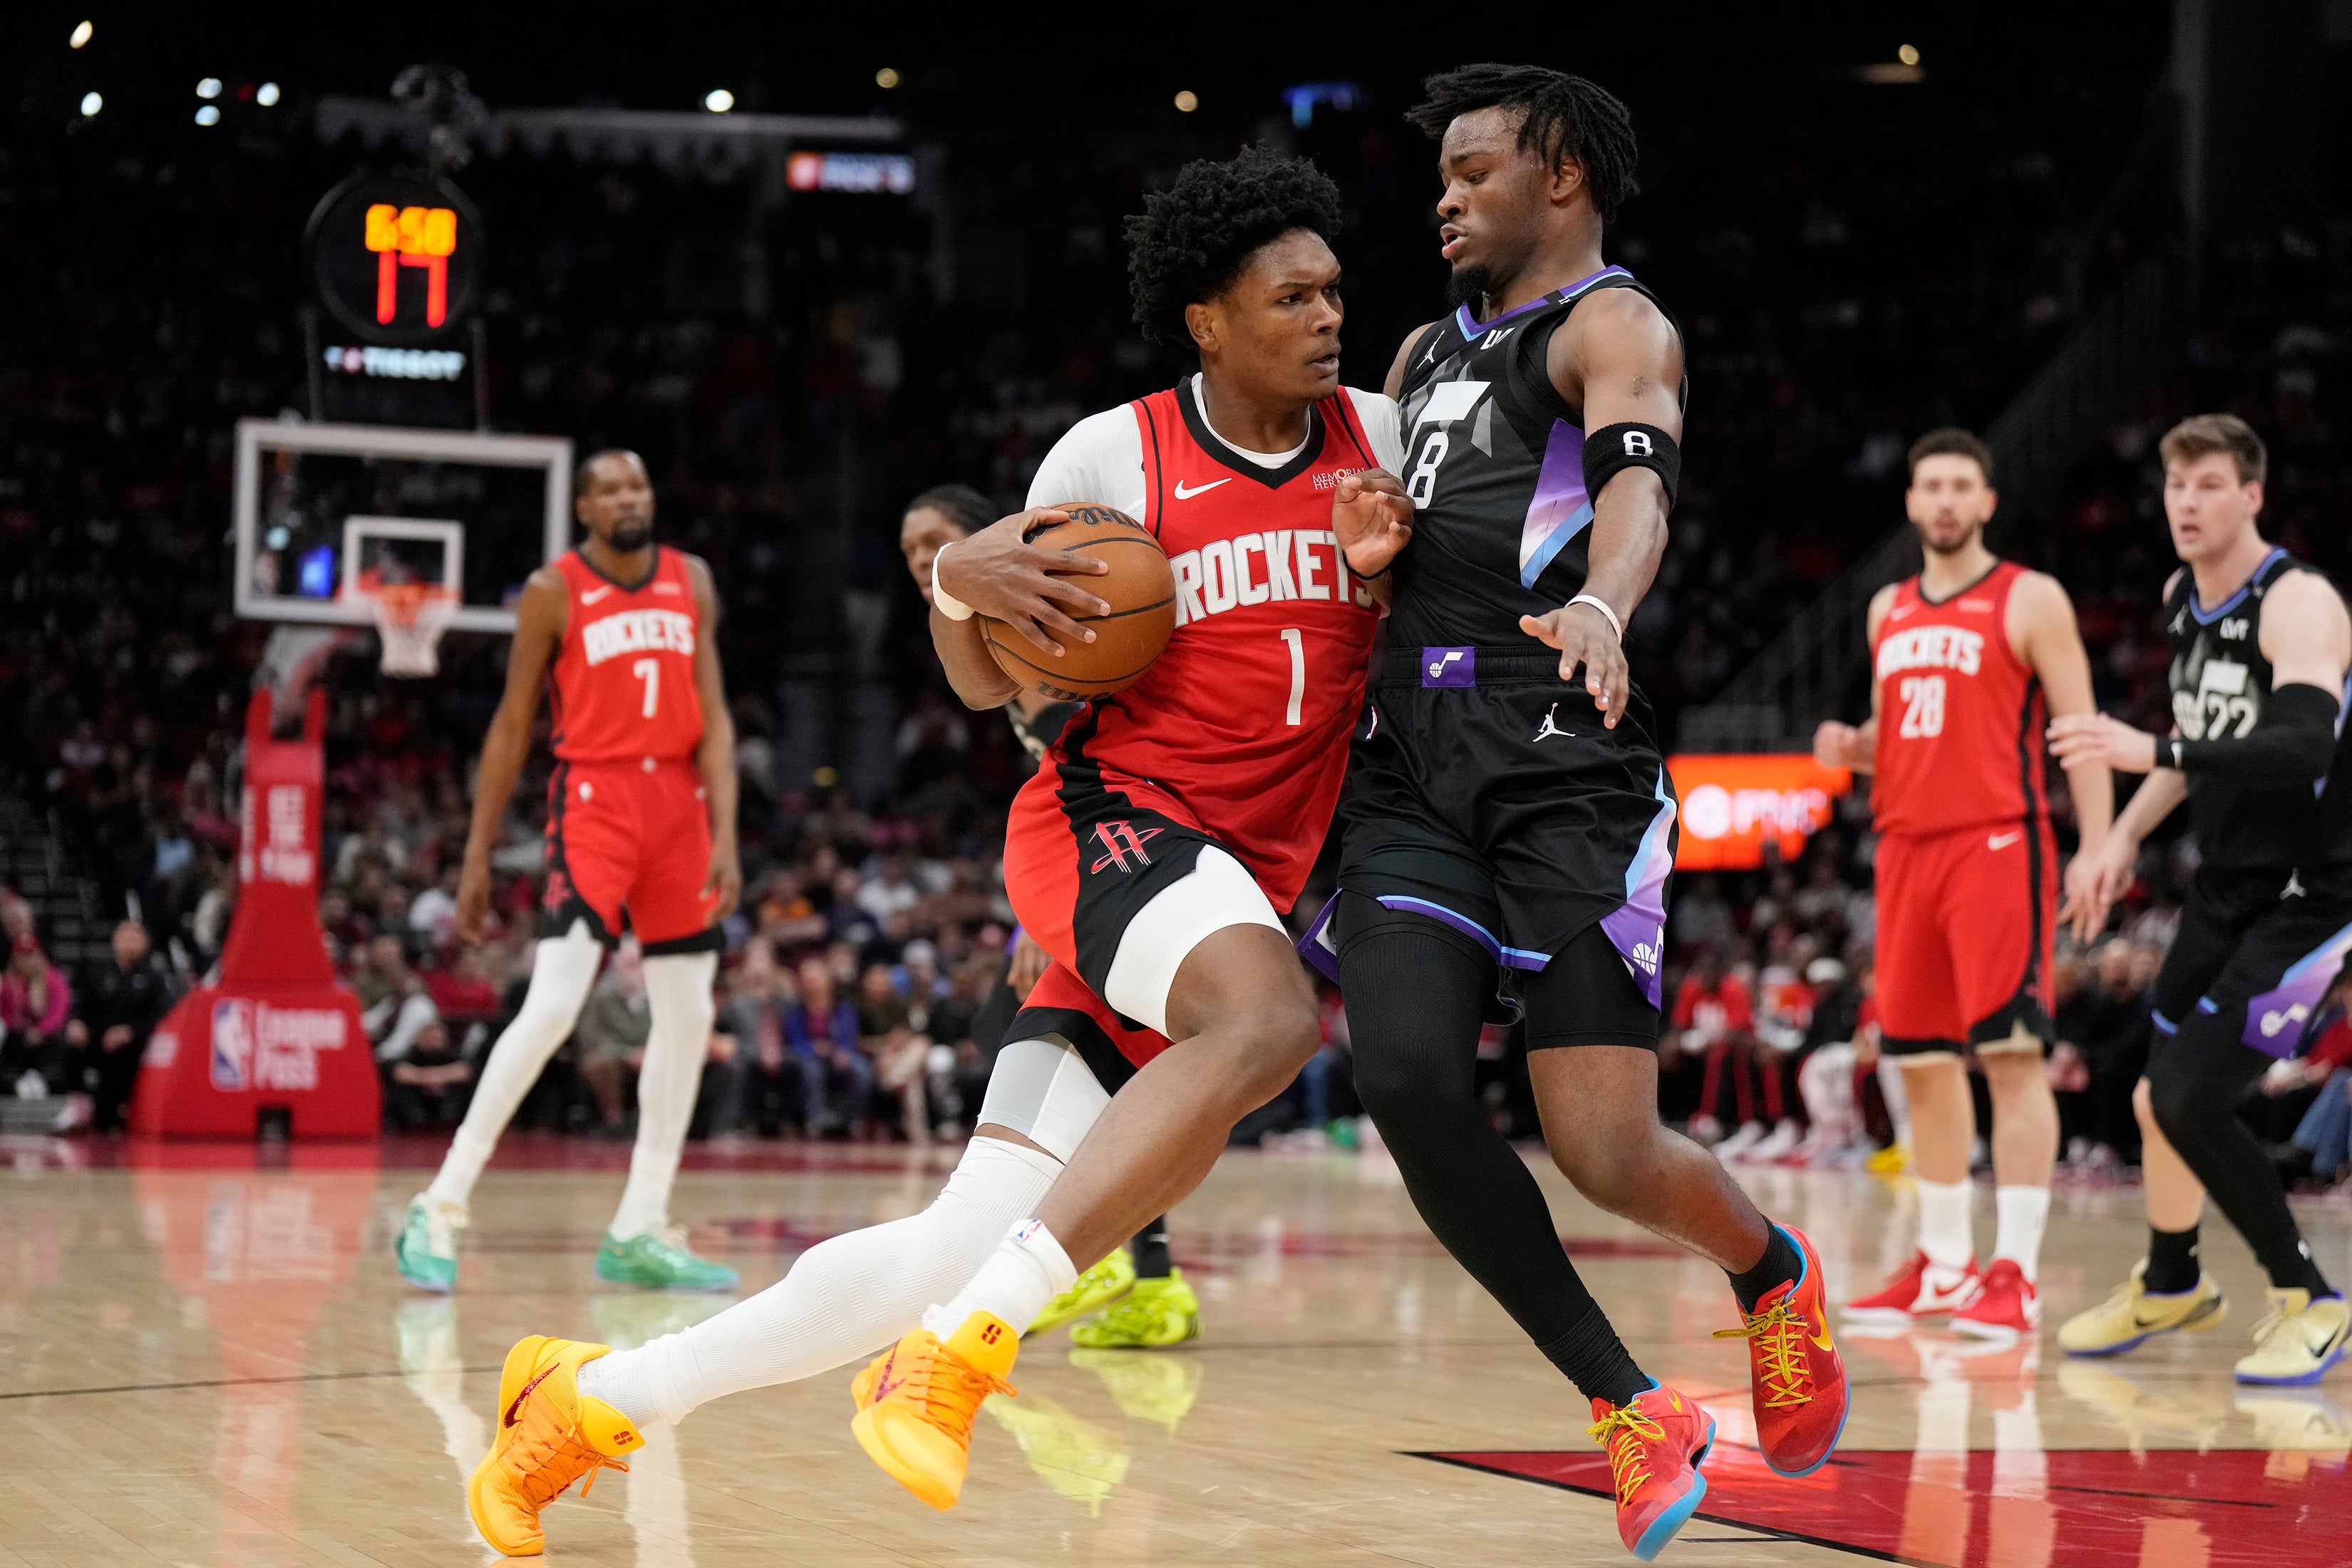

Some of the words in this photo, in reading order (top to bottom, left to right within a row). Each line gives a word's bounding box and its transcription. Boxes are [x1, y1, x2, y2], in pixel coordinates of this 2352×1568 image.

[1406, 431, 1449, 509] 8
[1623, 430, 1654, 456] 8
[634, 659, 659, 718] 7
[1281, 628, 1305, 726] 1
[1899, 675, 1946, 738] 28
